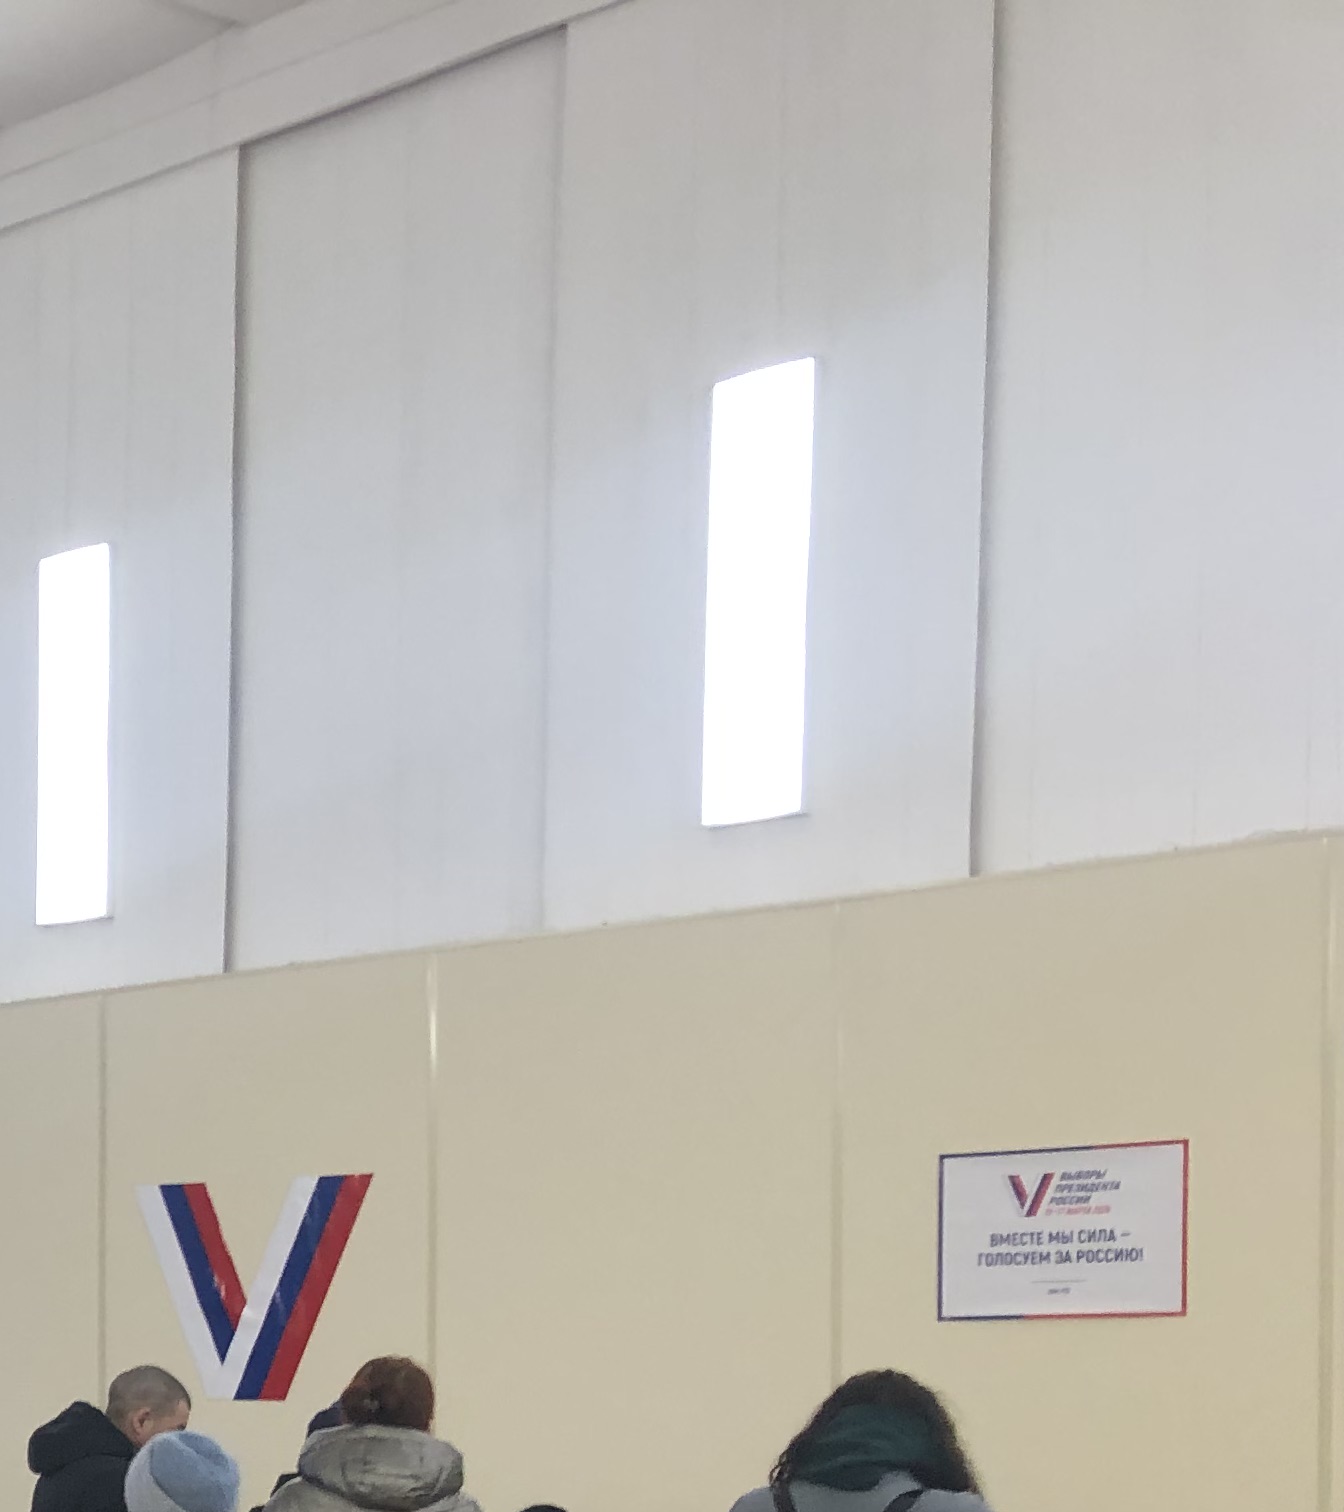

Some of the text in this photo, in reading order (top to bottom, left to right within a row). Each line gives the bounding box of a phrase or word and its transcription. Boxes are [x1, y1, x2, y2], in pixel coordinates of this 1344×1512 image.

[989, 1231, 1044, 1248] ВМЕСТЕ
[1048, 1229, 1074, 1245] МЫ
[1077, 1228, 1117, 1244] СИЛА
[977, 1247, 1144, 1268] ГОЛОСУЕМ ЗА РОССИЮ!
